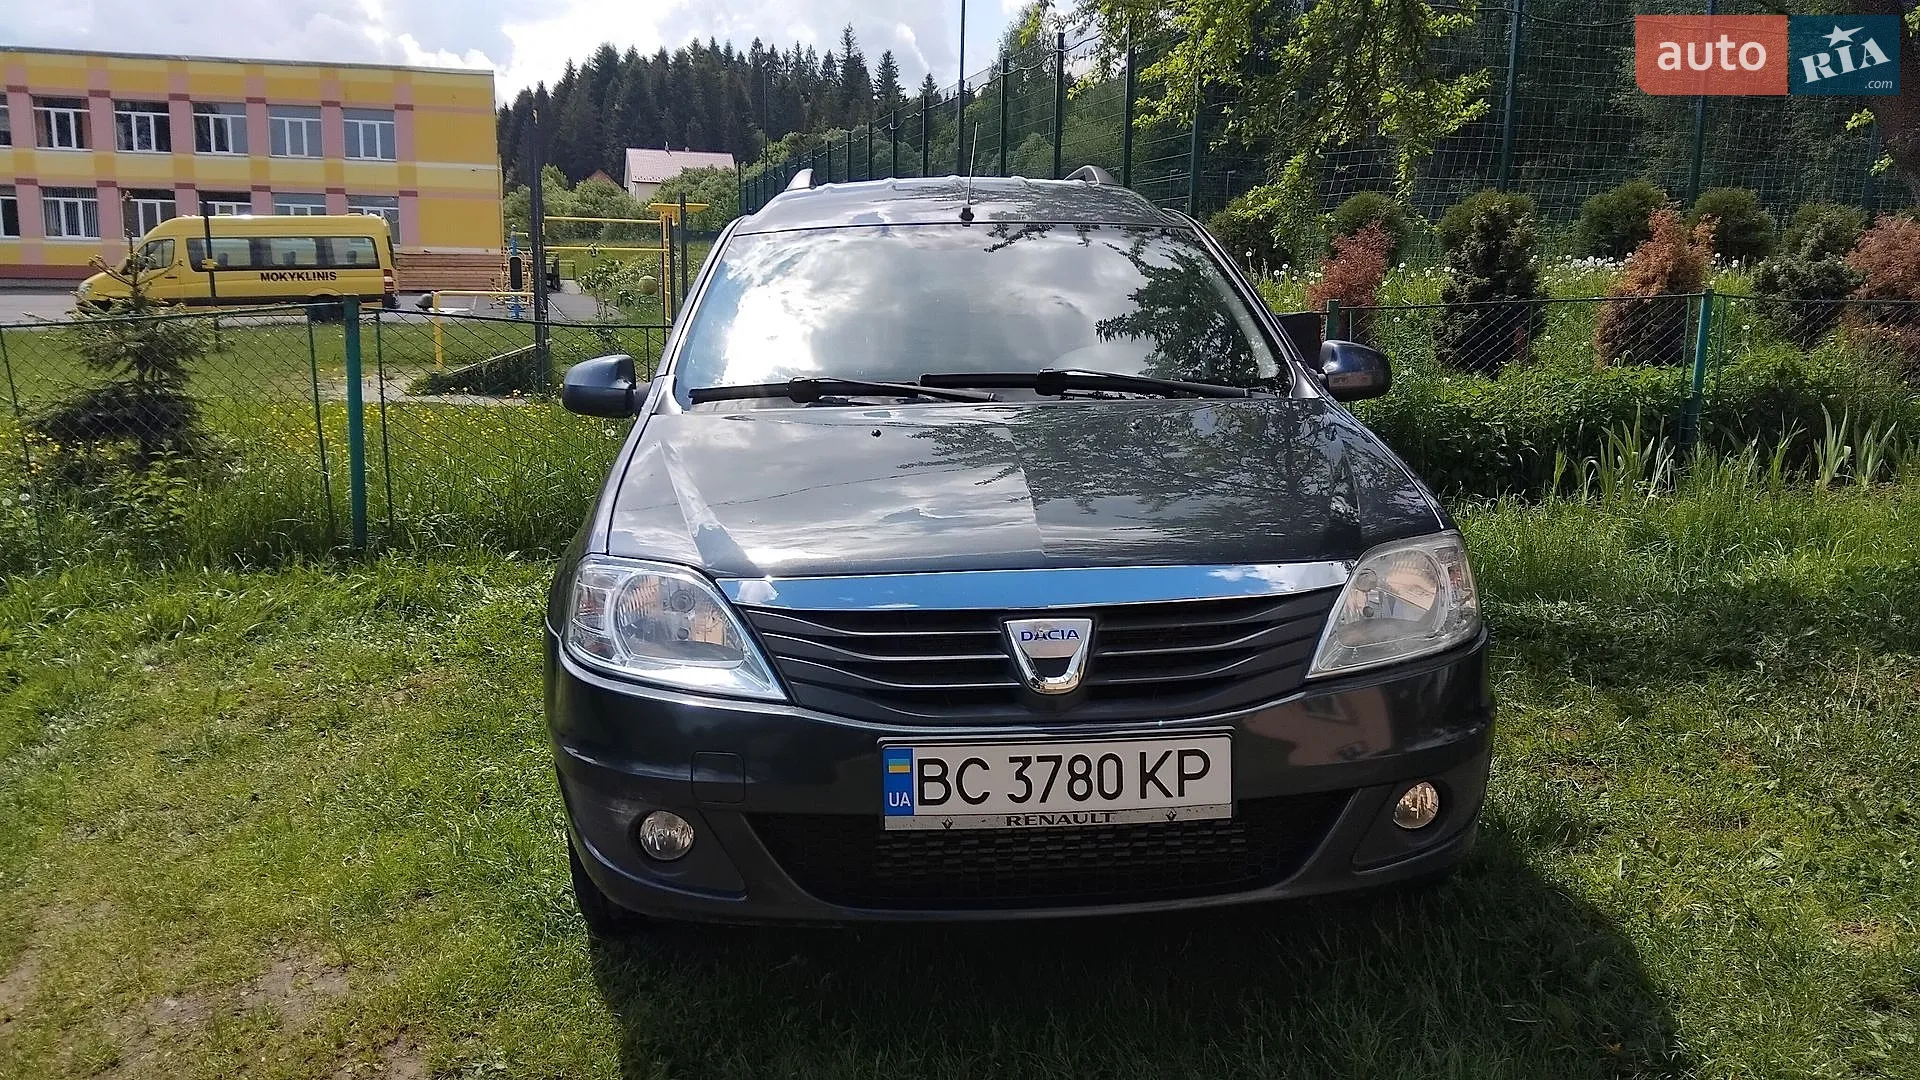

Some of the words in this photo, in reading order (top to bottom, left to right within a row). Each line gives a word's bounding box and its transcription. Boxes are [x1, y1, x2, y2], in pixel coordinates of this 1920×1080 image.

[260, 271, 337, 282] MOKYKLINIS
[1020, 629, 1080, 641] DACIA
[917, 757, 991, 806] BC
[1006, 753, 1124, 804] 3780
[1139, 748, 1211, 800] KP
[888, 792, 911, 807] UA
[1005, 812, 1117, 827] RENAULT
